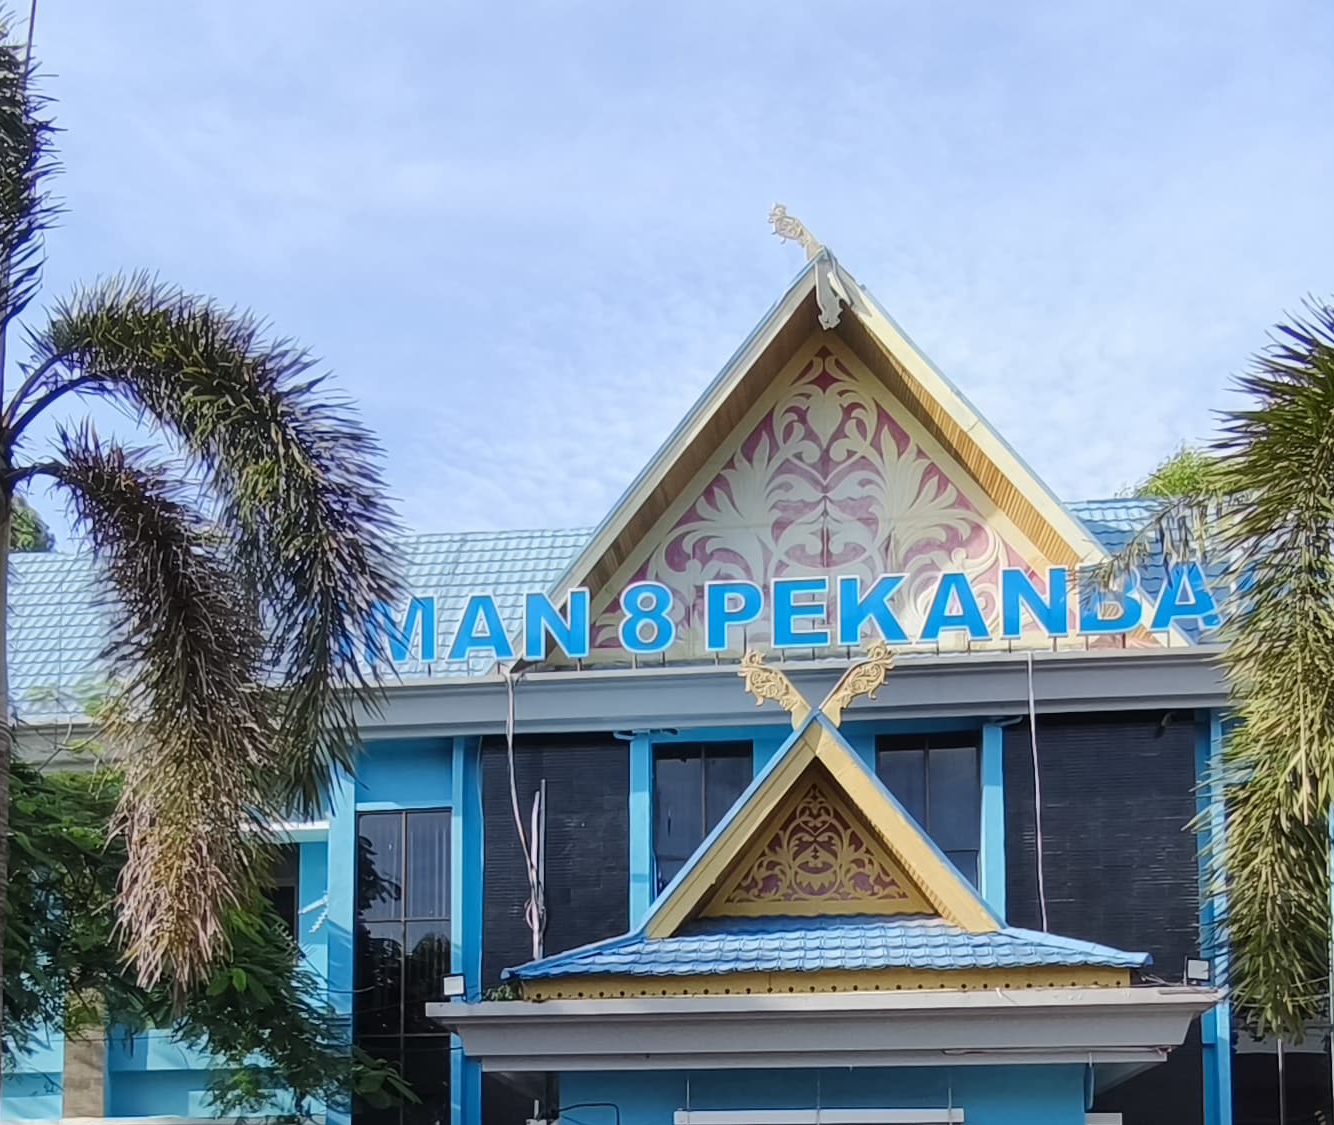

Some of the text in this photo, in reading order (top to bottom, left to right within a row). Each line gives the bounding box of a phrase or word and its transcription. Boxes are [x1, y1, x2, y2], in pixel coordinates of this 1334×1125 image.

[347, 559, 1257, 664] MAN 8 PEKANBA
